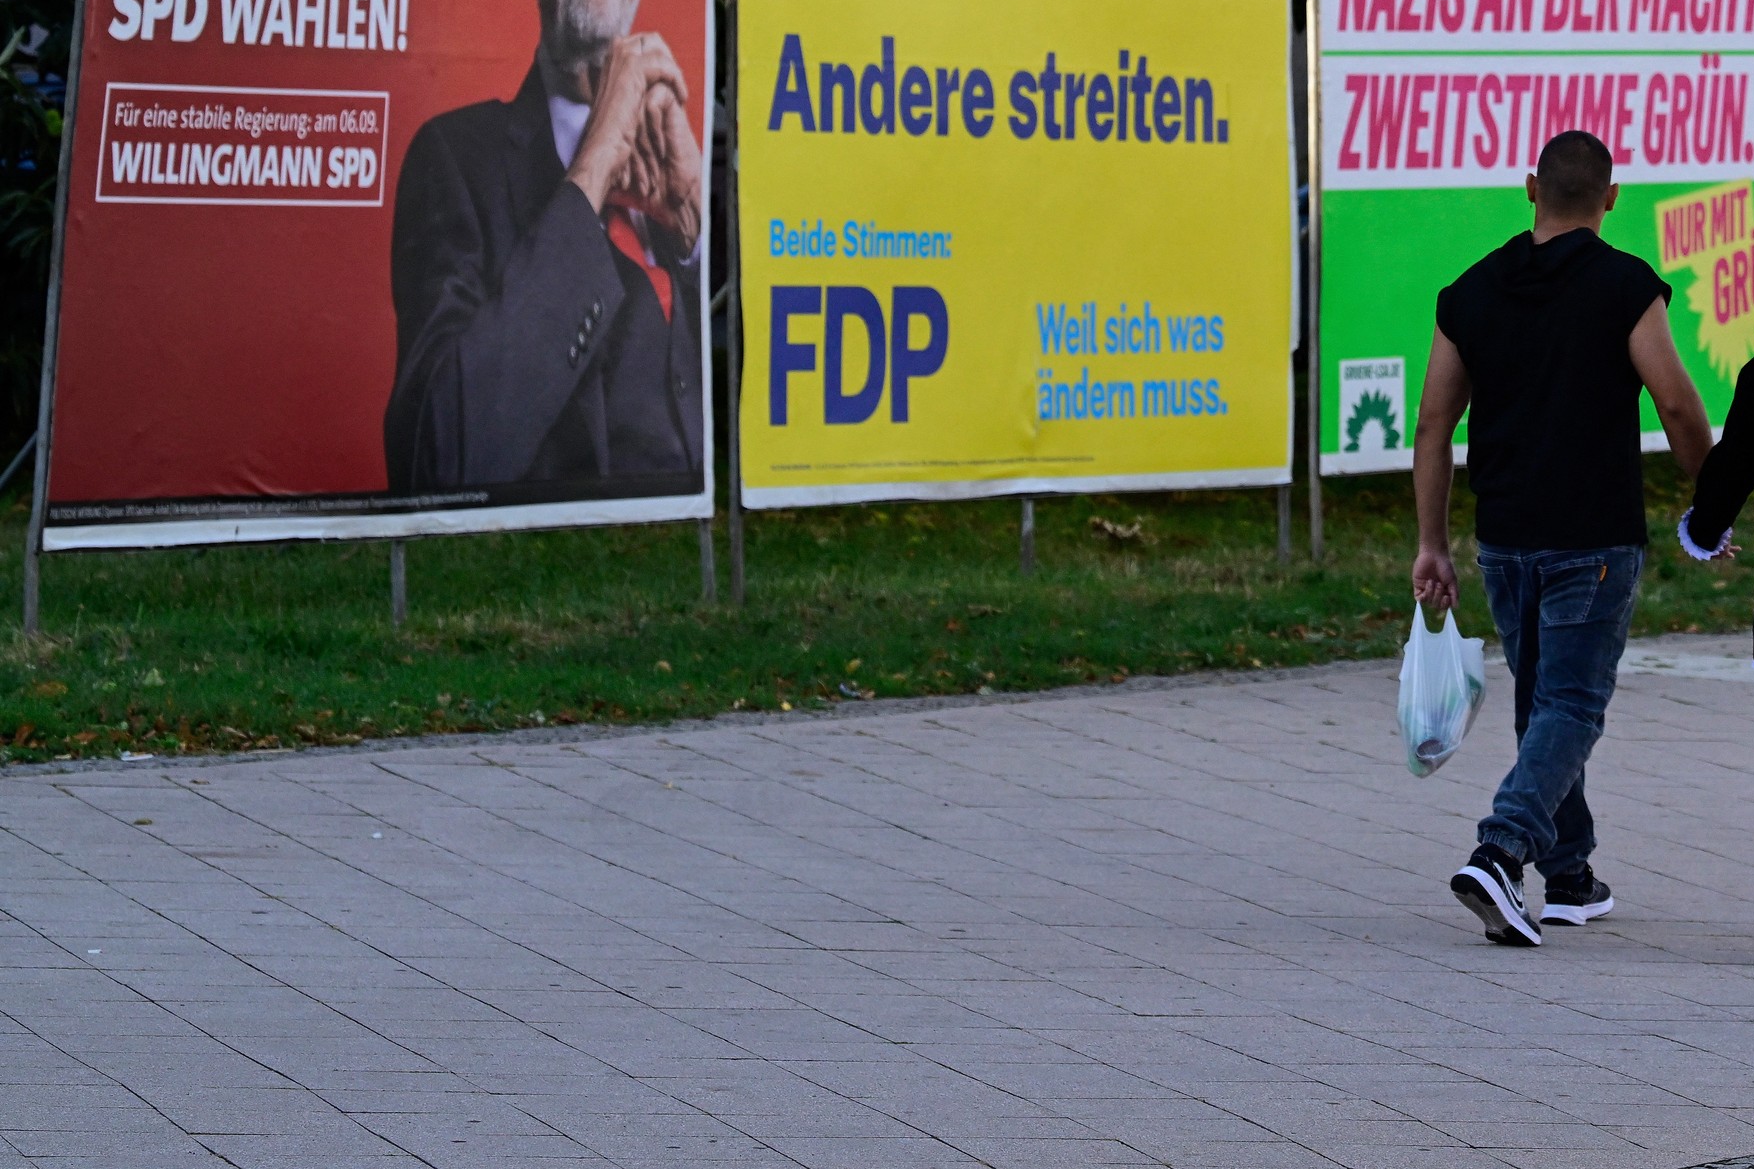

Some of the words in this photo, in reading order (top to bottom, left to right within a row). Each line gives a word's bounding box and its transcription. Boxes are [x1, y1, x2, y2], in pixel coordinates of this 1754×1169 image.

[767, 34, 996, 139] Andere
[1008, 49, 1229, 145] streiten.
[1339, 72, 1639, 170] ZWEITSTIMME
[1643, 53, 1754, 165] GRÜN.
[114, 102, 141, 127] Für
[143, 103, 177, 128] eine
[180, 104, 231, 130] stabile
[234, 106, 312, 139] Regierung:
[313, 113, 337, 132] am
[339, 109, 379, 134] 06.09.
[111, 141, 323, 187] WILLINGMANN
[326, 147, 377, 188] SPD
[769, 219, 837, 259] Beide
[842, 221, 952, 261] Stimmen:
[1664, 201, 1706, 262] NUR
[1711, 188, 1748, 248] MIT
[769, 285, 949, 427] FDP
[1036, 302, 1099, 356] Weil
[1104, 300, 1161, 355] sich
[1165, 313, 1225, 353] was
[1036, 367, 1136, 422] ändern
[1141, 376, 1228, 416] muss.
